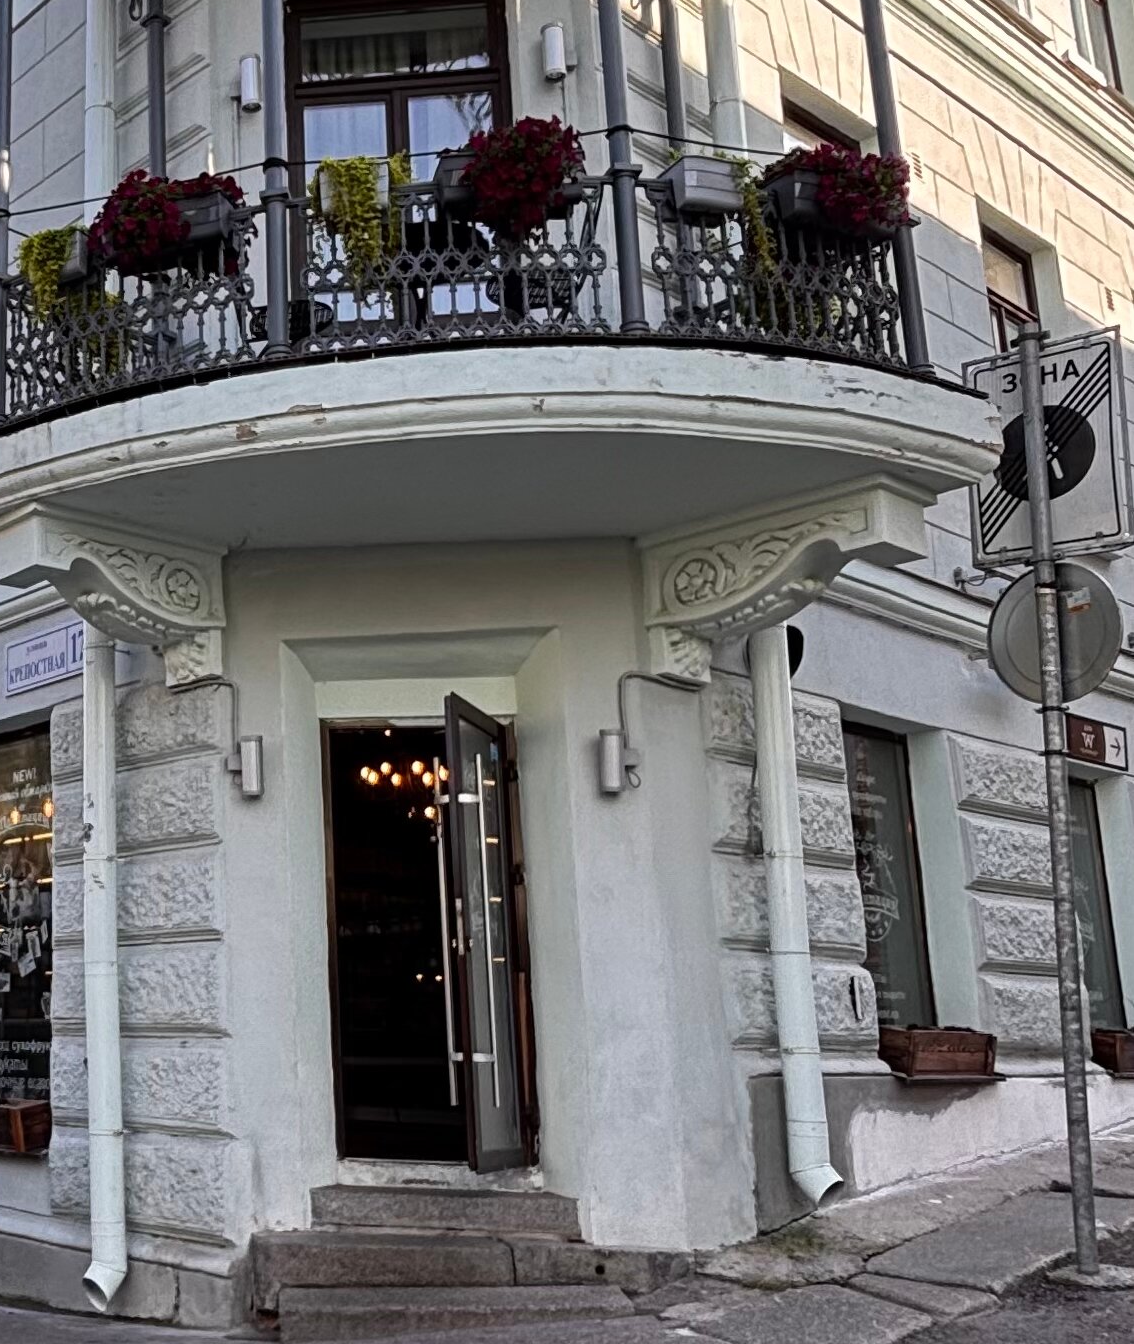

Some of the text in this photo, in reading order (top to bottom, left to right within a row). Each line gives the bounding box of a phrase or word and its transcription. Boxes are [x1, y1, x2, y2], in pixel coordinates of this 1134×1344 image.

[1002, 359, 1080, 393] ЗНА
[9, 652, 65, 685] КРЕПОСТНАЯ
[13, 768, 37, 783] NEW!
